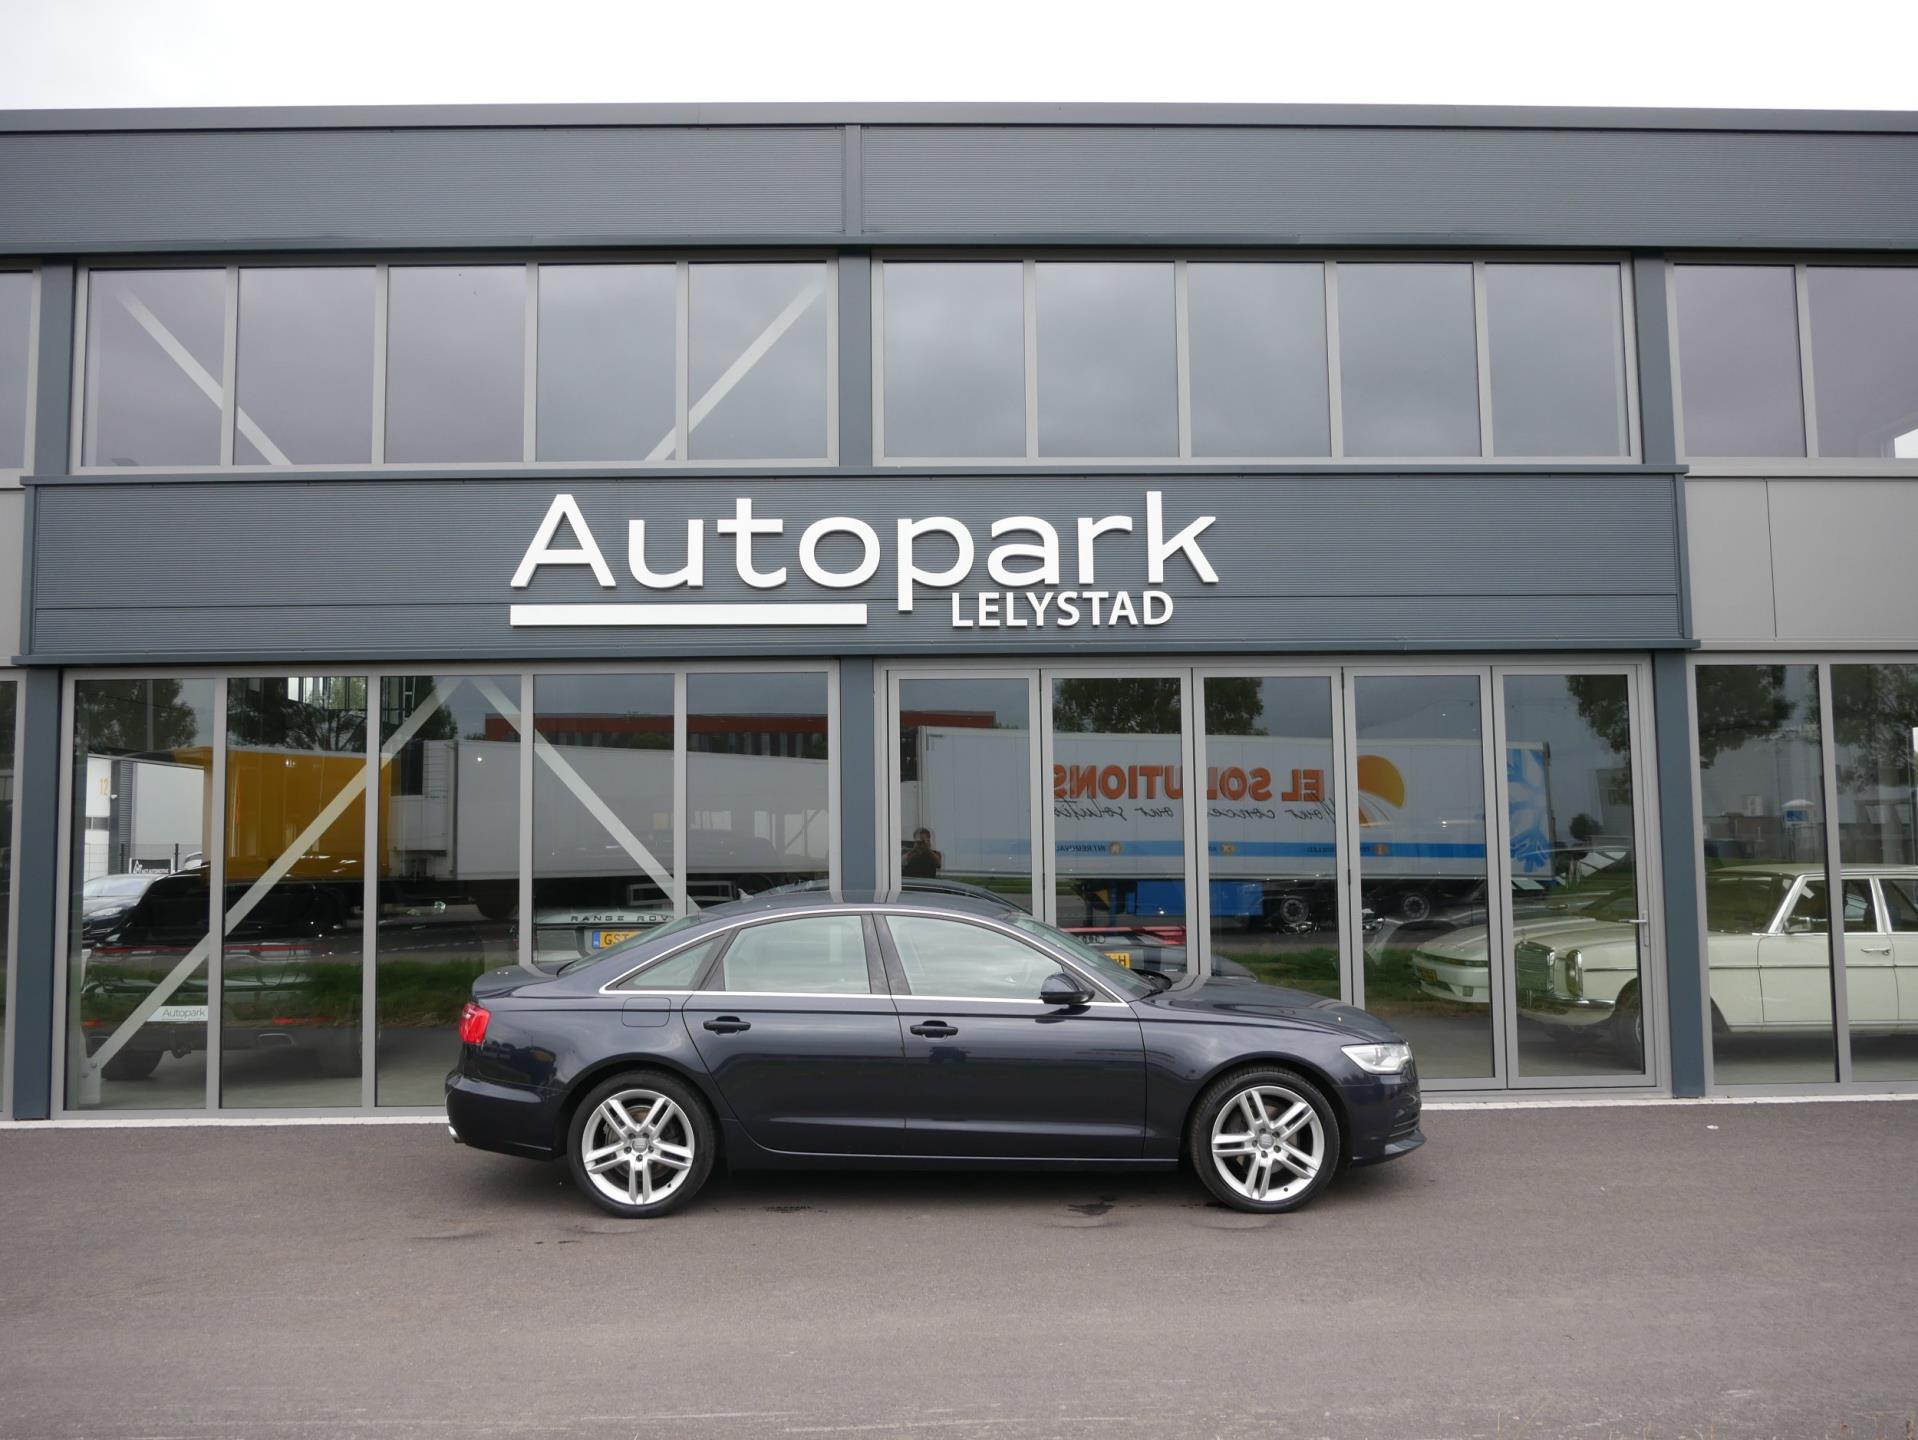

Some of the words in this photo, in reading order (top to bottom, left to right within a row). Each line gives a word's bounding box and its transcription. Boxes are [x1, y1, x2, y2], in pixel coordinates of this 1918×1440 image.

[510, 490, 1220, 612] Autopark
[951, 590, 1174, 628] LELYSTAD
[162, 1008, 206, 1019] Autopark
